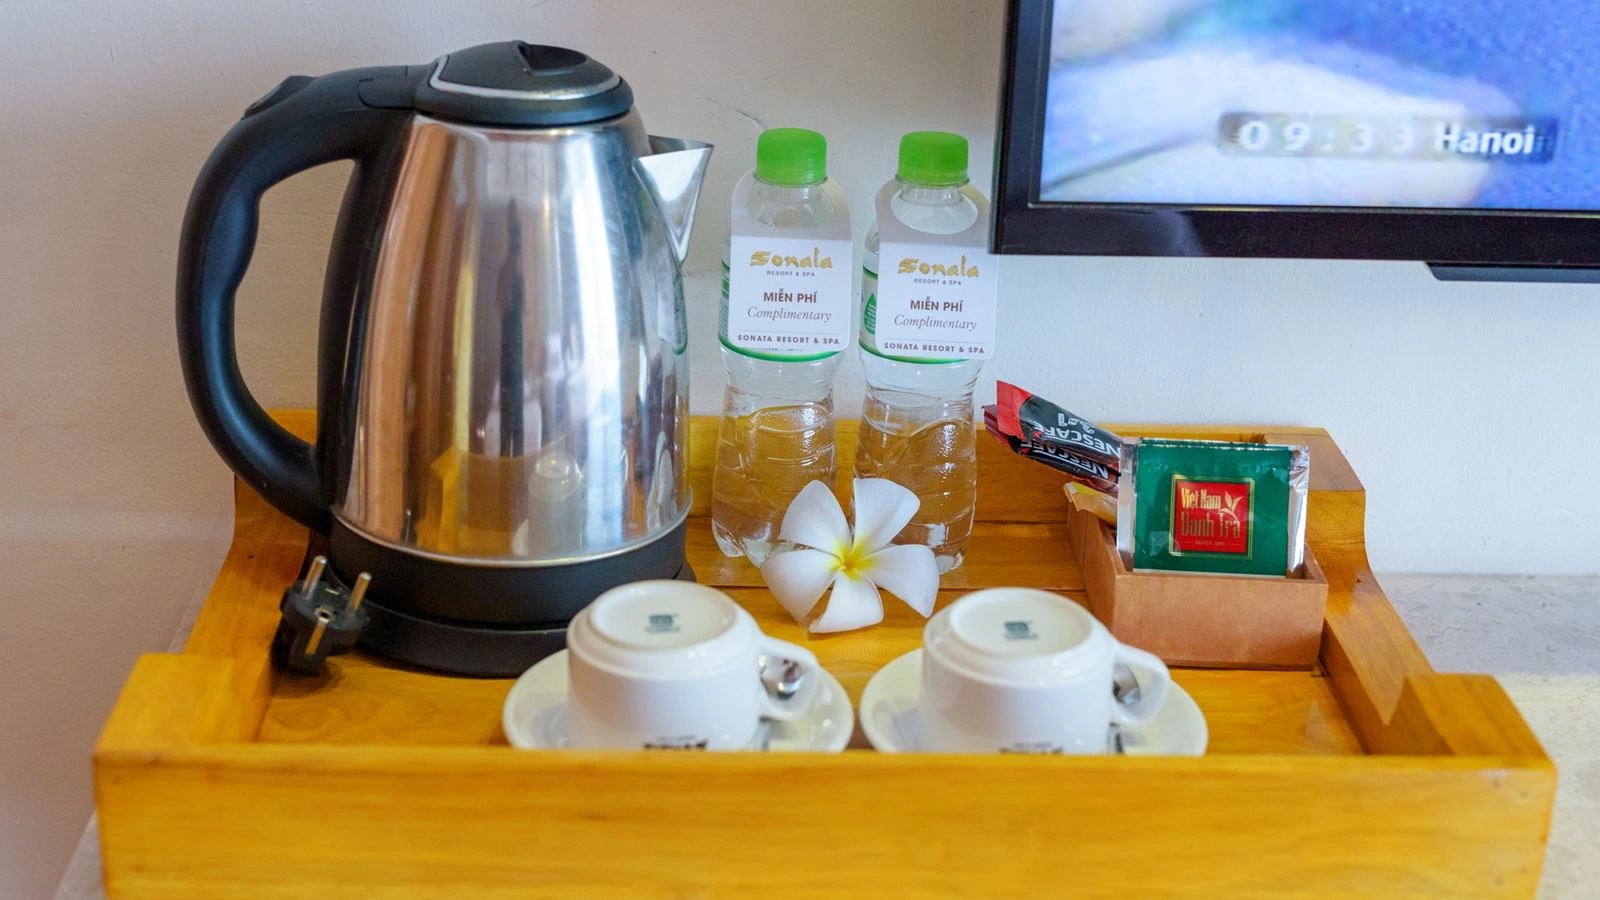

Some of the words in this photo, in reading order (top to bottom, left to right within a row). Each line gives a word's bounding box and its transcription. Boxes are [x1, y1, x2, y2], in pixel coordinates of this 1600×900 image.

[1438, 116, 1535, 155] Hanoi
[750, 246, 832, 269] Sonata
[897, 255, 979, 278] Sonata
[797, 290, 818, 304] PHÍ
[747, 306, 832, 323] Complimentary
[943, 300, 963, 312] PHÍ
[894, 314, 977, 332] Complimentary
[737, 334, 772, 342] SONATA
[777, 336, 809, 344] RESORT
[884, 342, 919, 351] SONATA
[923, 344, 955, 353] RESORT
[968, 346, 985, 354] SPA
[1181, 511, 1214, 538] Danh
